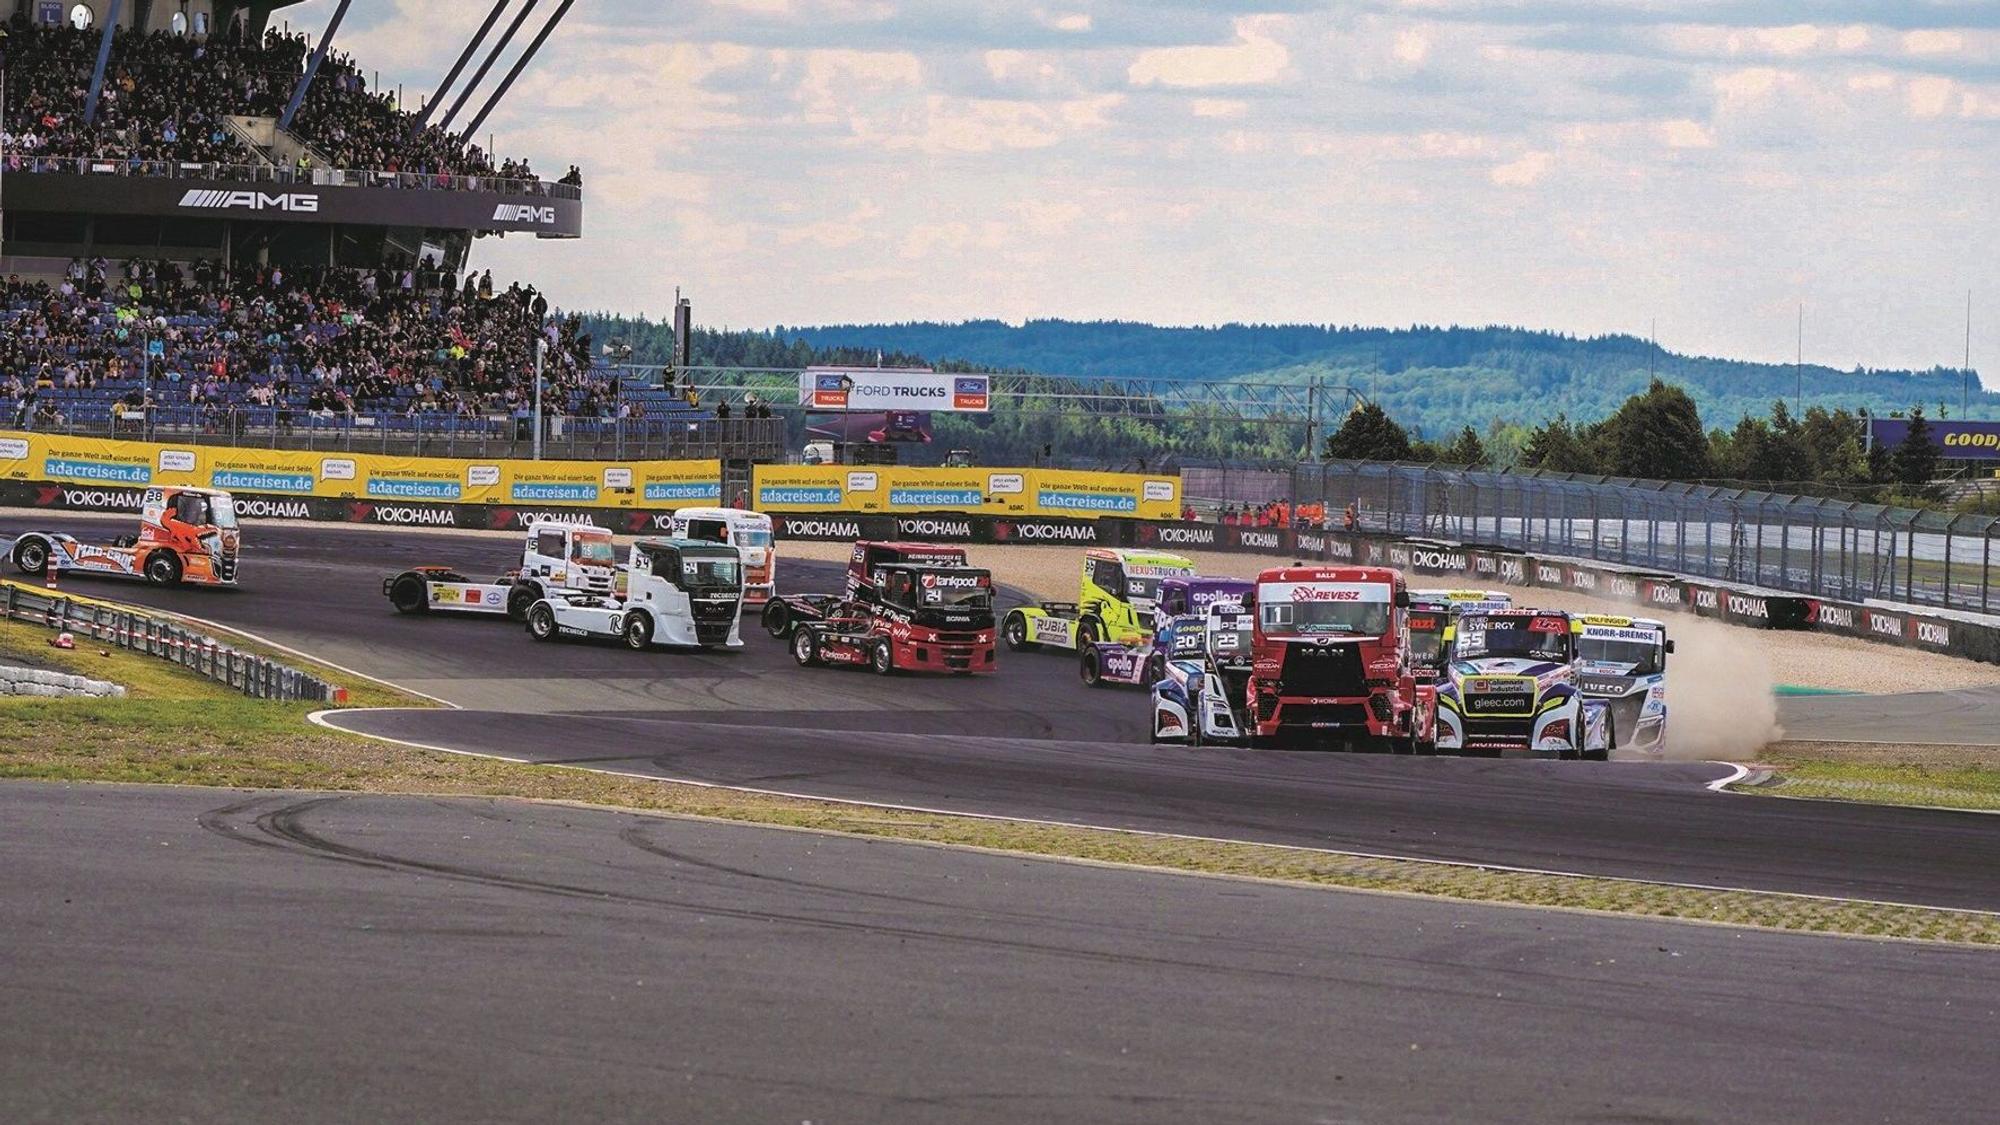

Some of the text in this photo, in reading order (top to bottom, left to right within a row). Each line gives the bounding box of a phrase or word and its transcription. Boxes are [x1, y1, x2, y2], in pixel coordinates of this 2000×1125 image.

[221, 190, 319, 212] AMG
[514, 205, 555, 223] AMG
[856, 385, 946, 398] FORD TRUCKS
[47, 461, 149, 481] adacreisen.de
[214, 472, 311, 490] adacreisen.de
[368, 480, 460, 497] adacreisen.de
[513, 485, 596, 499] adacreisen.de
[646, 484, 721, 499] adacreisen.de
[147, 490, 163, 503] 28
[761, 490, 840, 502] adacreisen.de
[891, 491, 980, 504] adacreisen.de
[1040, 494, 1135, 510] adacreisen.de
[375, 506, 454, 524] YOKOHAMA
[517, 512, 593, 527] YOKOHAMA
[785, 520, 860, 537] YOKOHAMA
[899, 519, 971, 537] YOKOHAMA
[1017, 524, 1096, 540] YOKOHAMA
[1158, 528, 1214, 543] YOKOHAMA
[1193, 590, 1231, 604] apollo
[1314, 591, 1360, 600] REVESZ
[1274, 607, 1281, 623] 1
[1587, 616, 1628, 625] PALFINGER
[1176, 625, 1206, 633] GOOD
[1469, 621, 1515, 631] SYNERGY
[1586, 628, 1654, 641] KNORR-BREMSE
[1176, 635, 1196, 649] 20
[1301, 648, 1345, 656] MAN
[1108, 655, 1132, 674] apollo
[1584, 682, 1623, 693] IVECO
[1474, 697, 1524, 709] gleec.com
